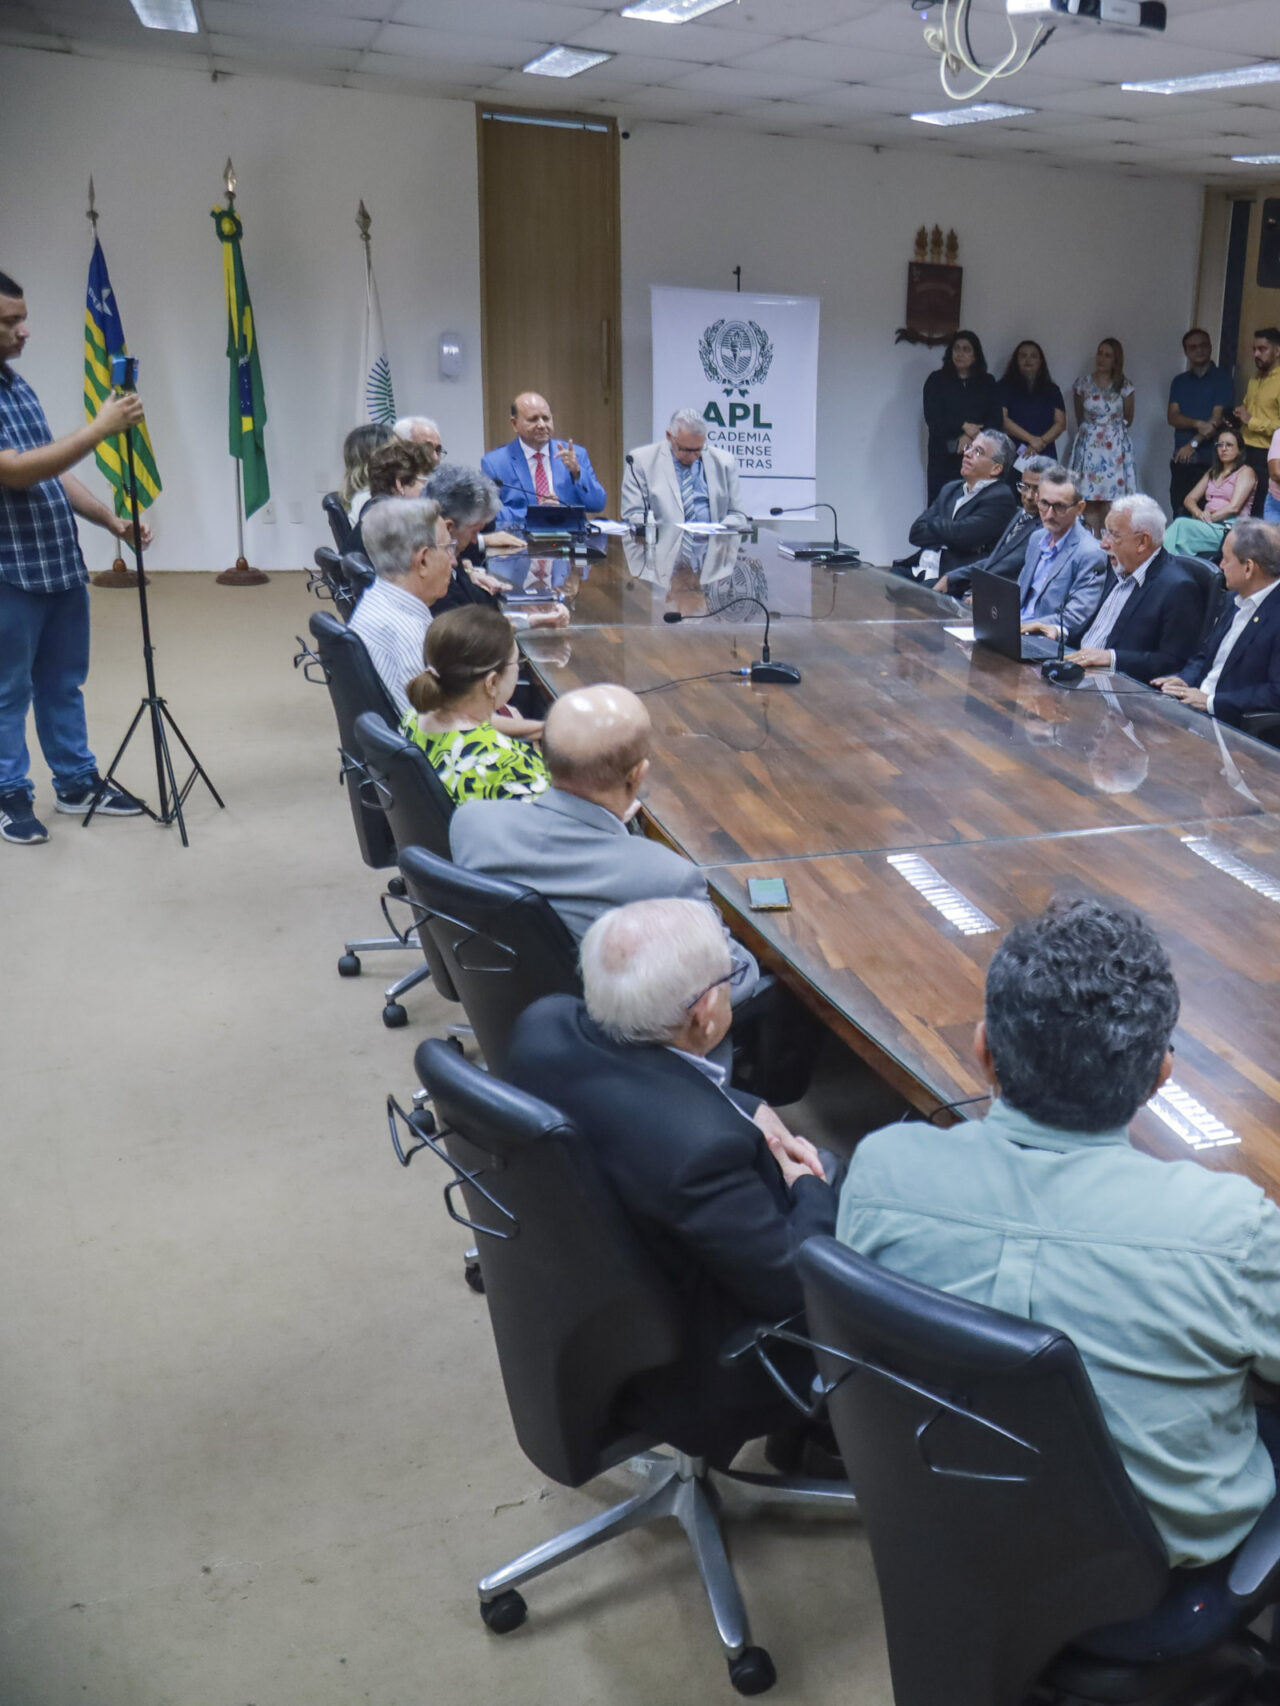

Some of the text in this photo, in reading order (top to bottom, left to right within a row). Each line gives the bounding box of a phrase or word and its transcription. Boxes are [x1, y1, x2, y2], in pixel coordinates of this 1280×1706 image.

[703, 401, 772, 429] APL
[707, 431, 771, 443] CADEMIA
[736, 458, 772, 469] TRAS
